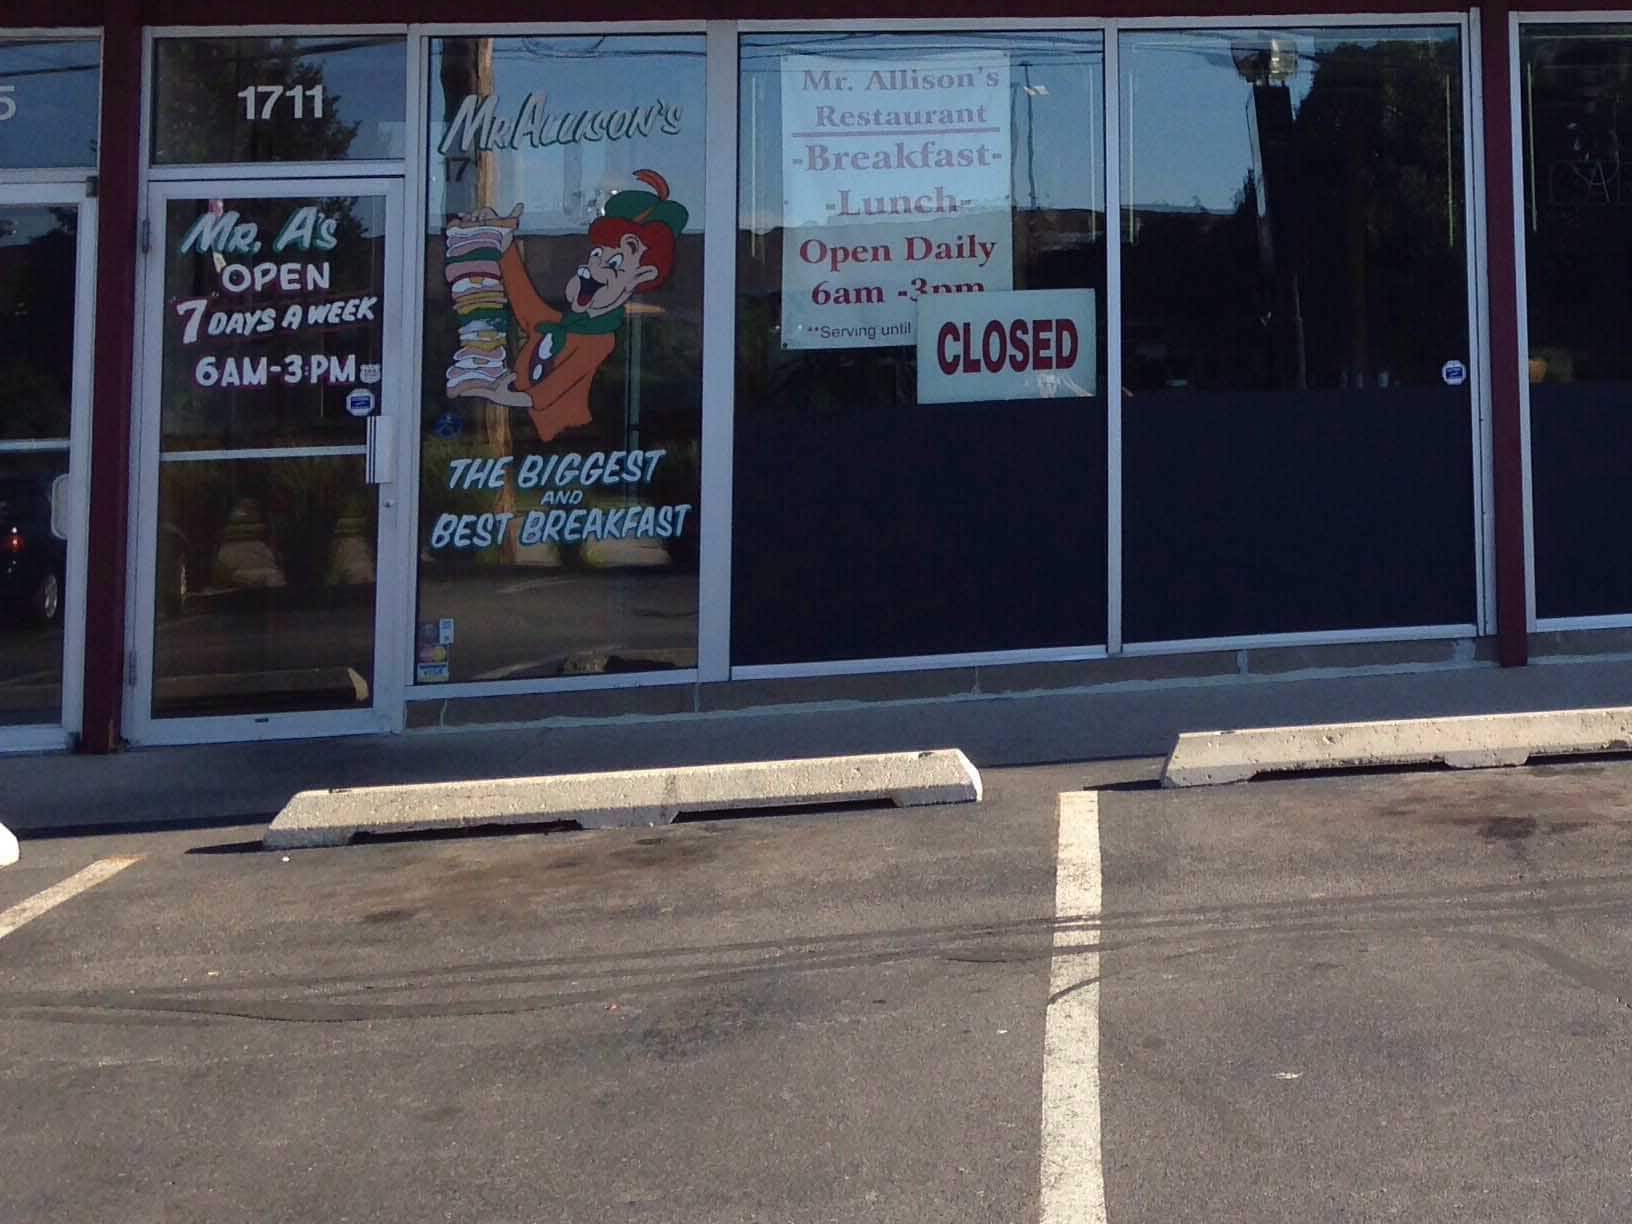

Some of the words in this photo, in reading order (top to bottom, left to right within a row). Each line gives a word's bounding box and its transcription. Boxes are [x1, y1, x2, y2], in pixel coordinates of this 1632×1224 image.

[801, 69, 853, 92] Mr.
[865, 65, 1000, 91] Allison's
[237, 84, 324, 120] 1711
[815, 103, 988, 127] Restaurant
[799, 238, 892, 273] Open
[904, 233, 998, 268] Daily
[221, 261, 331, 293] OPEN
[811, 281, 884, 307] 6am
[176, 298, 208, 345] 7
[207, 307, 277, 336] DAYS
[281, 304, 303, 330] A
[307, 296, 378, 326] WEEK
[881, 321, 912, 336] until
[936, 318, 1079, 376] CLOSED
[449, 455, 514, 490] THE
[517, 449, 667, 489] BIGGEST
[540, 489, 585, 505] AND
[431, 512, 514, 549] BEST
[521, 503, 693, 545] BREAKFAST
